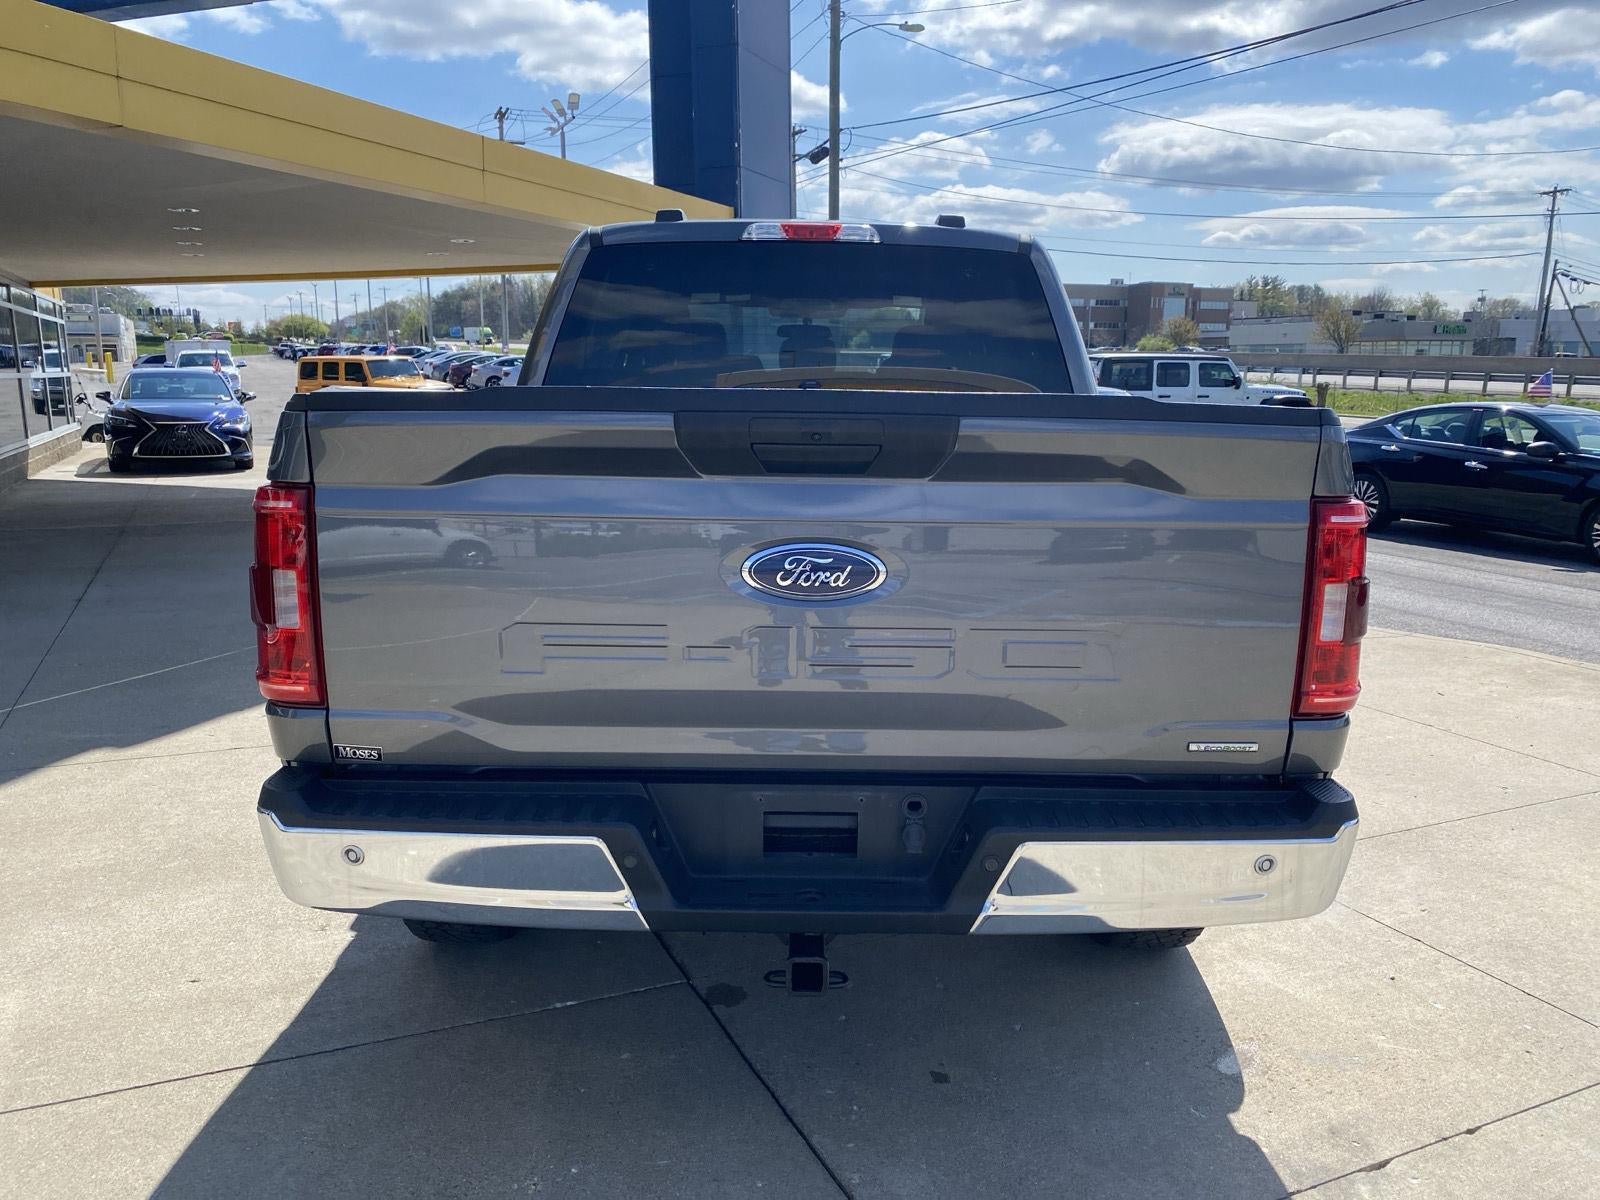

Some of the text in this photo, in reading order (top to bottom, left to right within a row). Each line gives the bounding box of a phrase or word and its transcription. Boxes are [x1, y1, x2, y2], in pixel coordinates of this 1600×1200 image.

[776, 555, 852, 587] Ford
[499, 622, 1119, 682] F-150
[338, 746, 379, 760] MOSES
